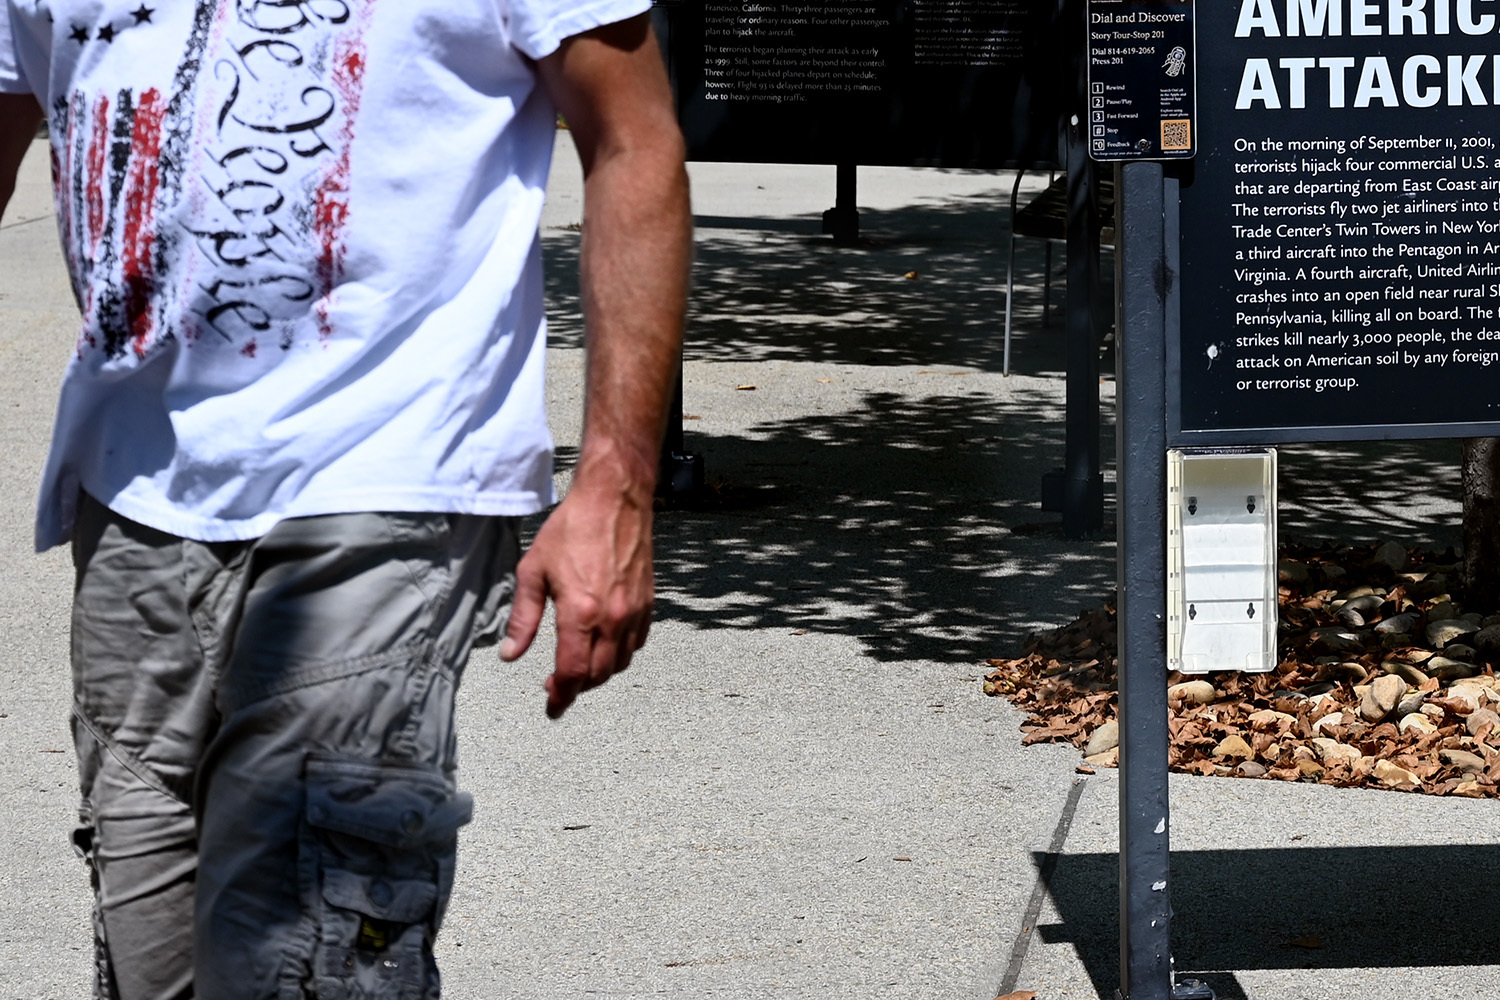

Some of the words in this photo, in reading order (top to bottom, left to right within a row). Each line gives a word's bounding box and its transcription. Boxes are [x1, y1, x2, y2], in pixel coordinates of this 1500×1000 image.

[1091, 12, 1113, 23] Dial
[1115, 12, 1136, 23] and
[1138, 12, 1186, 23] Discover
[1091, 31, 1111, 41] Story
[1112, 30, 1150, 40] Tour-Stop
[1151, 30, 1164, 38] 201
[1091, 47, 1106, 55] Dial
[1107, 46, 1155, 55] 814-619-2065
[1092, 57, 1110, 65] Press
[1234, 138, 1256, 151] On
[1261, 137, 1283, 151] the
[1288, 136, 1346, 154] morning
[1349, 135, 1366, 149] of
[1367, 134, 1442, 153] September
[1461, 137, 1495, 149] 2001,
[1234, 159, 1297, 173] terrorists
[1301, 157, 1341, 176] hijack
[1345, 157, 1375, 171] four
[1377, 155, 1456, 171] commercial
[1461, 155, 1488, 169] U.S.
[1234, 181, 1264, 195] that
[1267, 184, 1289, 194] are
[1293, 179, 1360, 198] departing
[1364, 178, 1397, 192] from
[1402, 178, 1432, 192] East
[1436, 177, 1476, 191] Coast
[180, 57, 335, 344] People
[1231, 202, 1259, 216] The
[1263, 202, 1326, 216] terrorists
[1329, 200, 1348, 219] fly
[1351, 204, 1378, 214] two
[1380, 200, 1400, 218] jet
[1403, 199, 1458, 213] airliners
[1461, 198, 1488, 212] into
[1231, 223, 1272, 238] Trade
[1276, 223, 1332, 238] Center's
[1334, 222, 1368, 236] Twin
[1371, 222, 1421, 235] Towers
[1425, 221, 1437, 234] in
[1442, 221, 1473, 234] New
[1235, 250, 1244, 260] a
[1248, 245, 1281, 260] third
[1286, 244, 1336, 259] aircraft
[1340, 244, 1367, 258] into
[1371, 243, 1394, 257] the
[1398, 243, 1461, 260] Pentagon
[1466, 241, 1478, 254] in
[1233, 267, 1290, 286] Virginia.
[1295, 267, 1306, 280] A
[1310, 265, 1354, 280] fourth
[1358, 264, 1412, 280] aircraft,
[1417, 262, 1462, 277] United
[1235, 289, 1287, 305] crashes
[1291, 288, 1319, 302] into
[1323, 291, 1340, 301] an
[1345, 290, 1379, 305] open
[1384, 285, 1414, 300] field
[1419, 289, 1449, 299] near
[1453, 284, 1484, 298] rural
